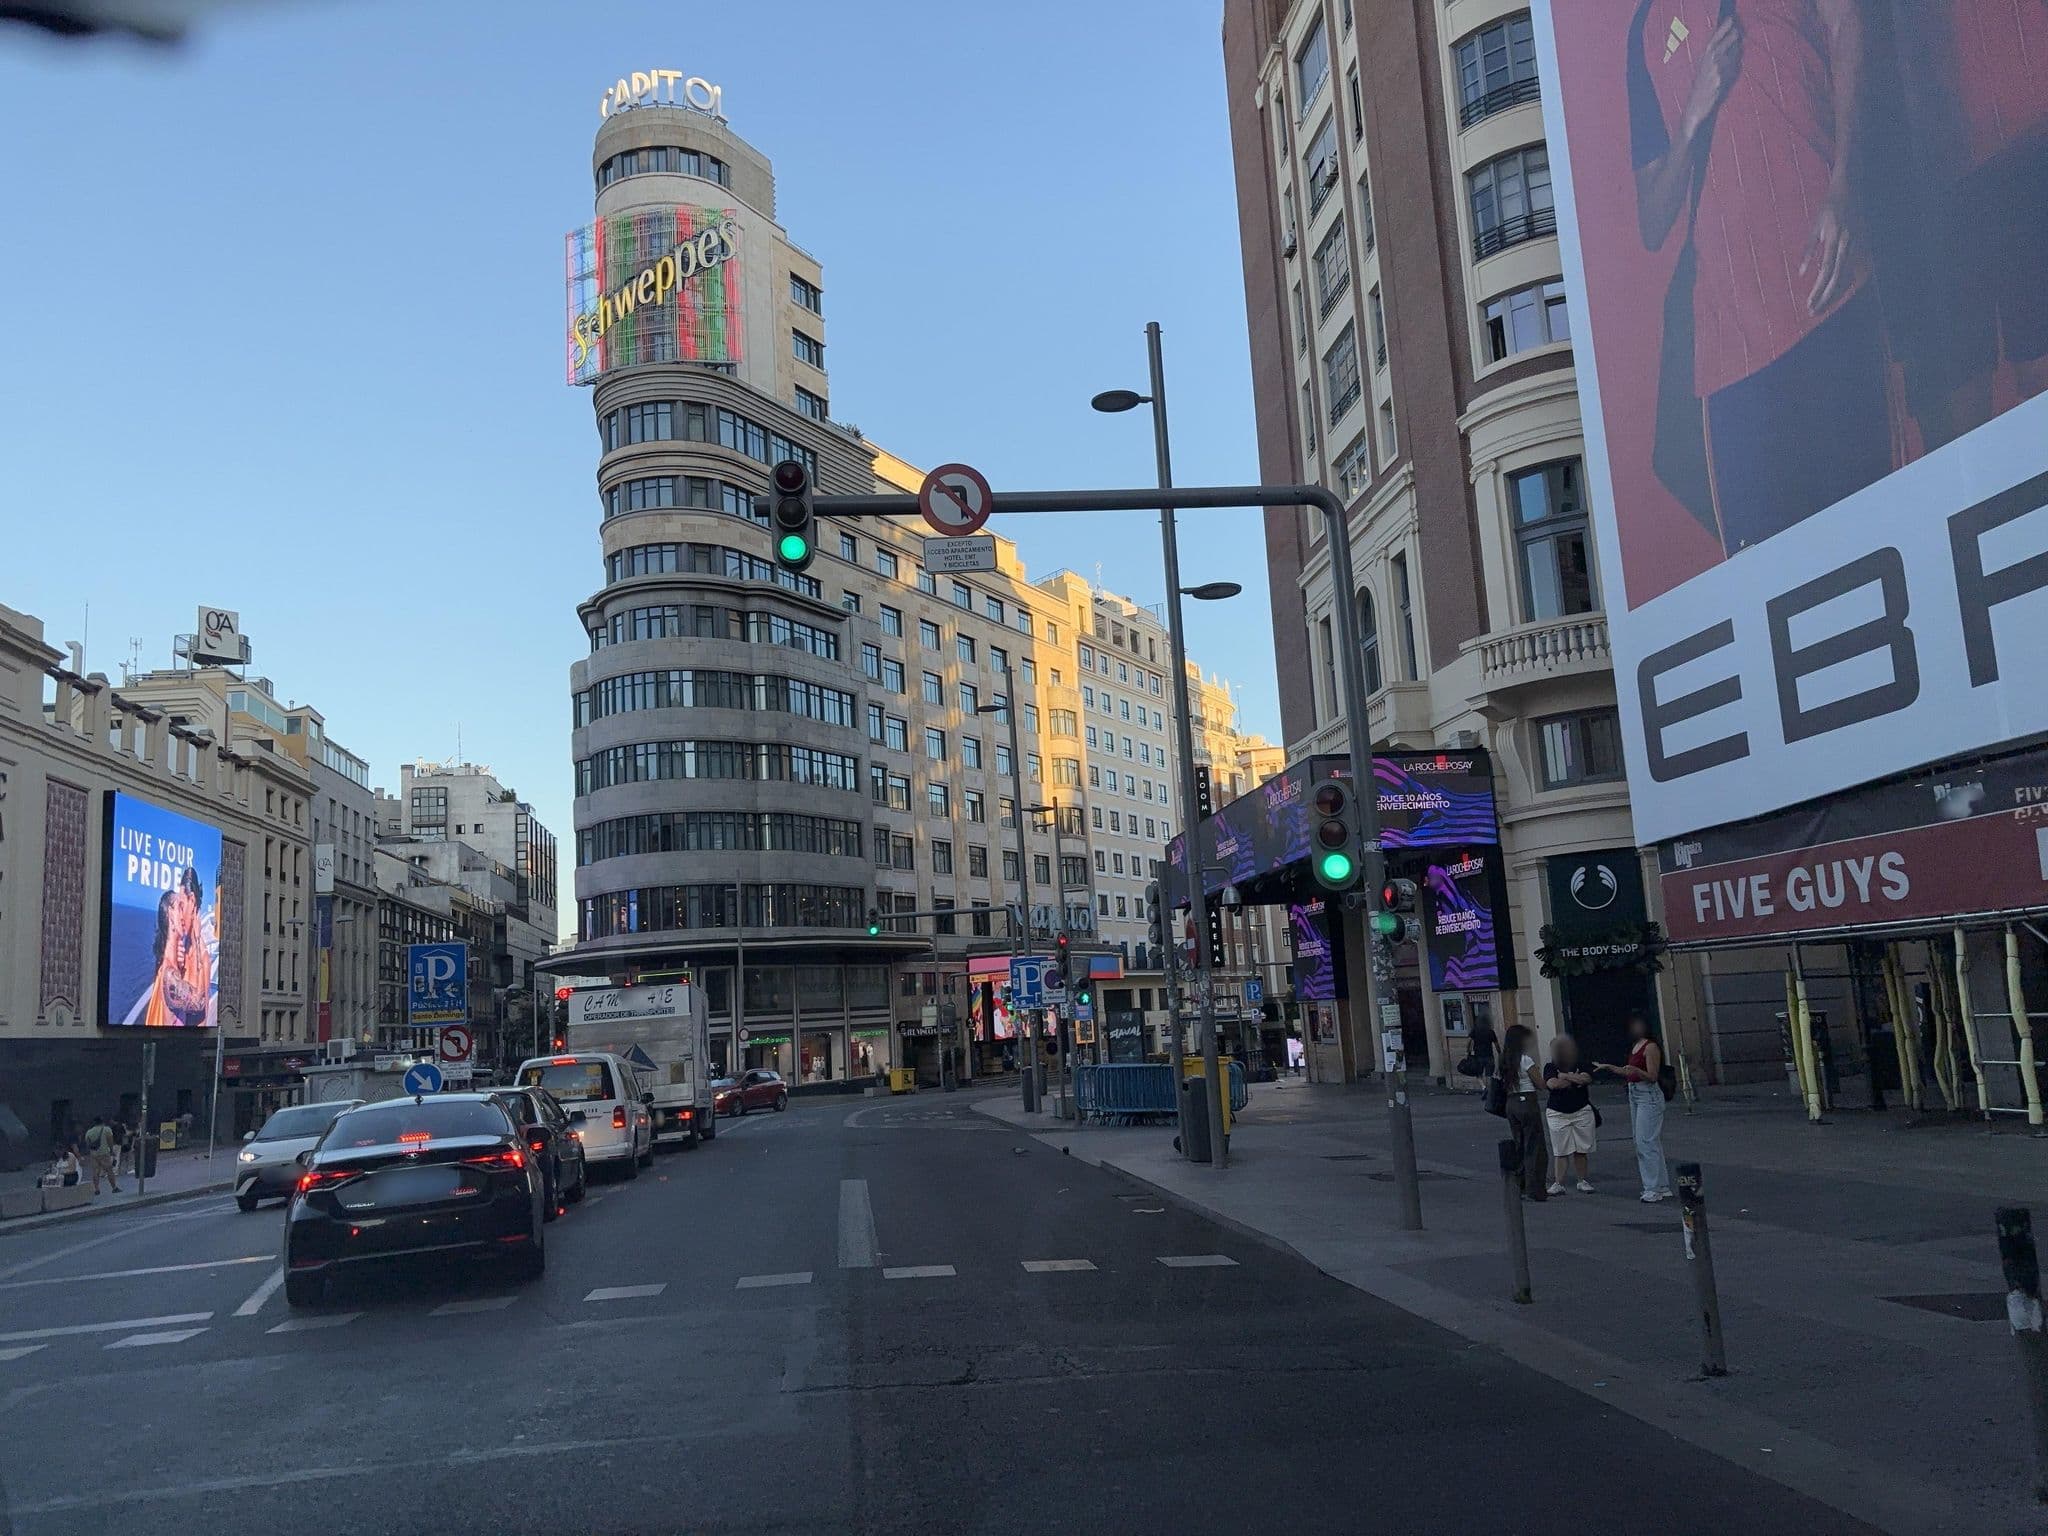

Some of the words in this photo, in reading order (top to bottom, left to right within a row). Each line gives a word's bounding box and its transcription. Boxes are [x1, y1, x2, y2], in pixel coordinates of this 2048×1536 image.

[601, 69, 729, 125] CAPITOL
[573, 216, 738, 369] Schweppes
[948, 560, 980, 568] BICICLETAS
[950, 546, 993, 554] APARCAMIENTO
[1403, 763, 1415, 772] LA
[1405, 794, 1416, 802] 10
[1416, 791, 1442, 801] AÑOS
[120, 826, 152, 857] LIVE
[158, 838, 194, 867] YOUR
[128, 854, 183, 893] PRIDE
[1692, 871, 1775, 923] FIVE
[1785, 851, 1911, 913] GUYS
[1210, 911, 1221, 963] ARENA
[1560, 947, 1580, 957] THE
[1582, 945, 1610, 956] BODY
[1611, 943, 1639, 954] SHOP
